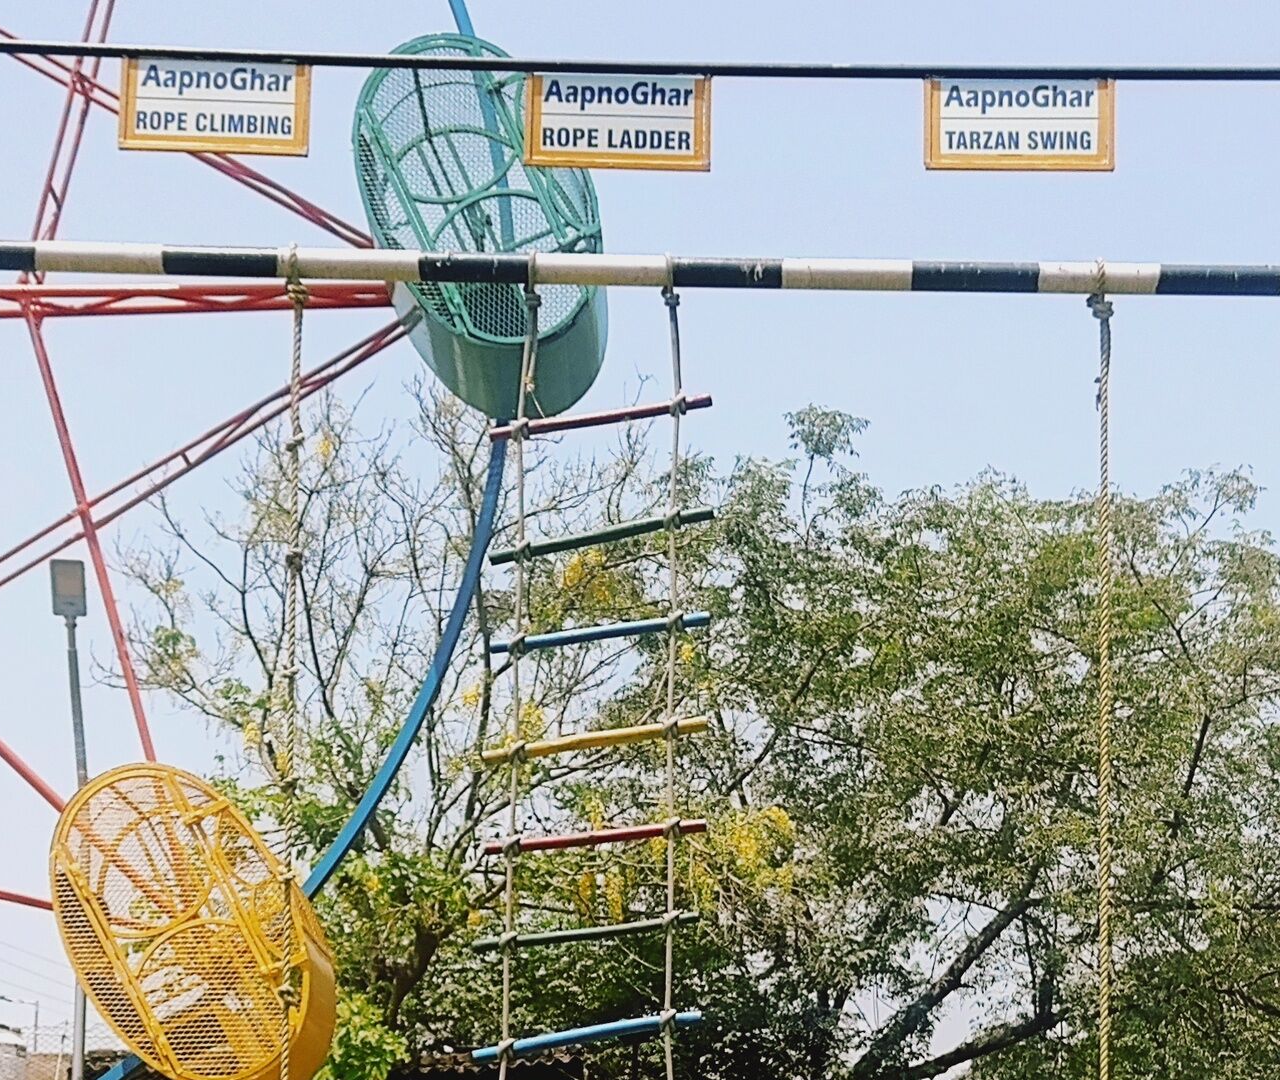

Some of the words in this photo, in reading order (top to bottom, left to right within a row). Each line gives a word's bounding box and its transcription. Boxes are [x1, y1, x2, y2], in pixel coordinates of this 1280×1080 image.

[141, 64, 292, 96] AapnoGhar
[543, 79, 693, 111] AapnoGhar
[944, 84, 1094, 114] AapnoGhar
[136, 110, 187, 131] ROPE
[195, 112, 292, 135] CLIMBING
[542, 127, 599, 148] ROPE
[607, 128, 691, 150] LADDER
[945, 130, 1019, 150] TARZAN
[1027, 130, 1091, 150] SWING
